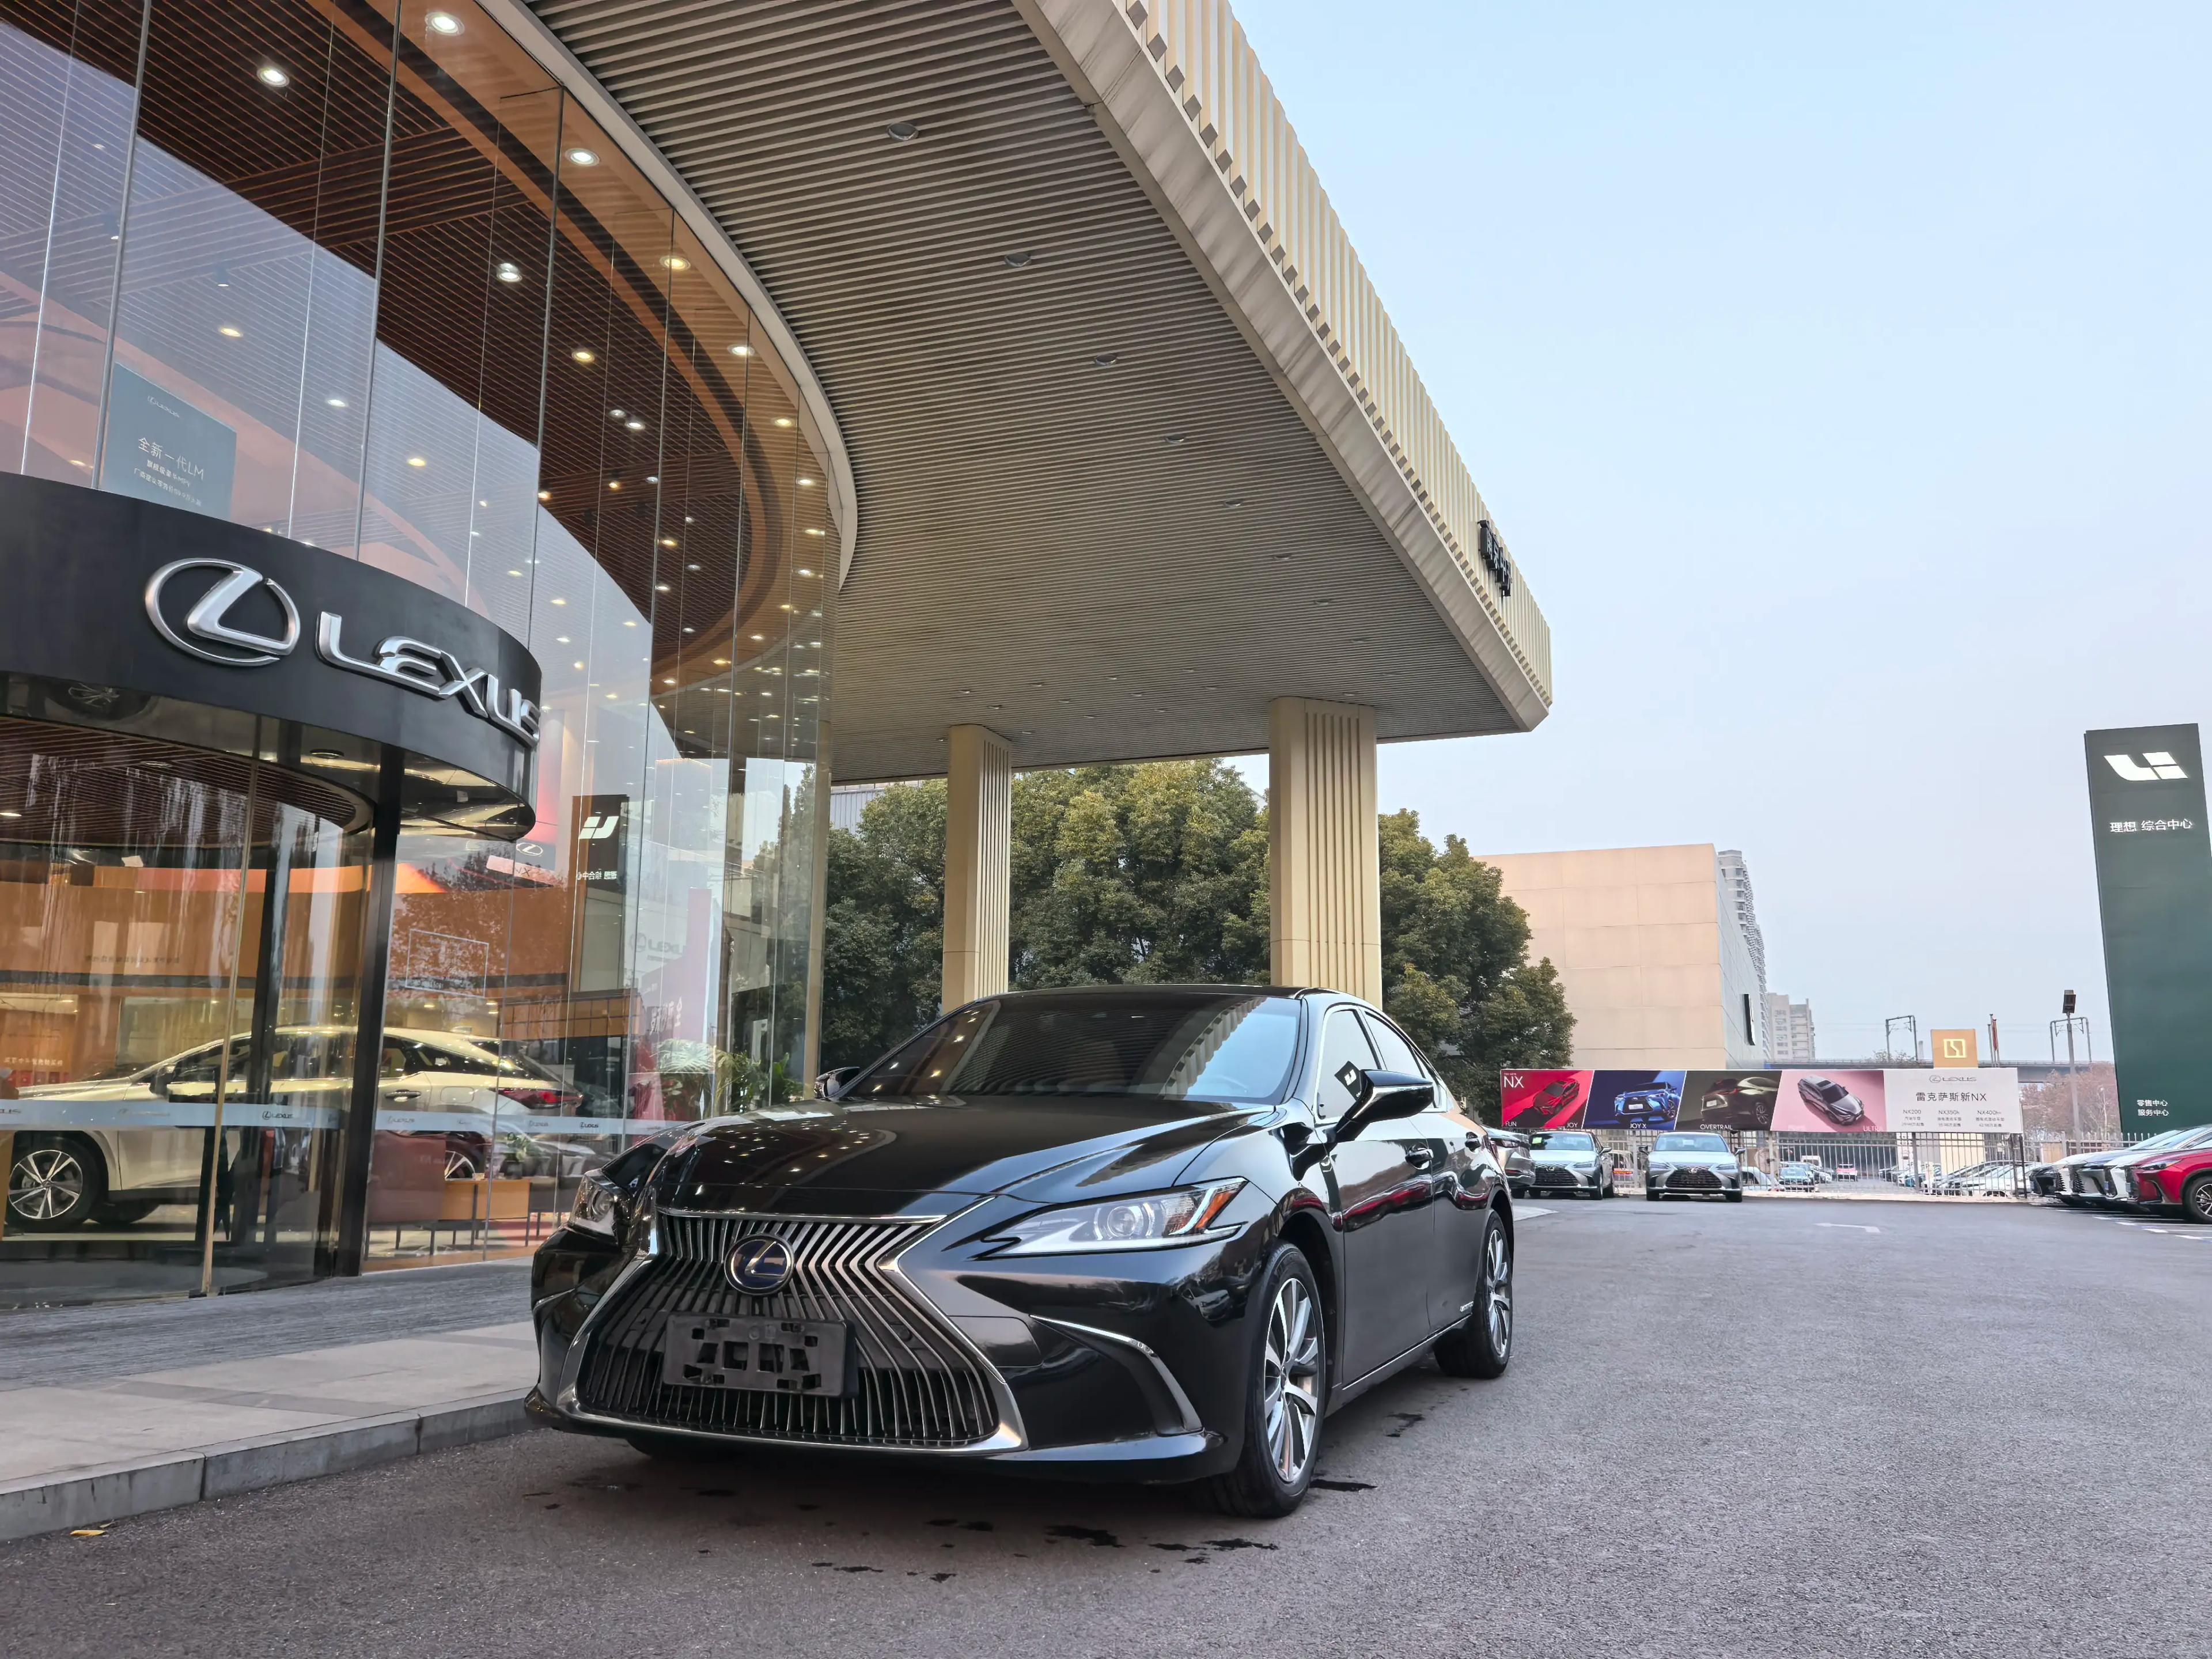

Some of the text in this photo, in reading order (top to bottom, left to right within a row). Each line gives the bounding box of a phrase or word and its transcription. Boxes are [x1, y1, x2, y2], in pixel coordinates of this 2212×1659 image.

[138, 437, 204, 480] 全新一代LM
[315, 611, 541, 748] LEXUS
[2109, 819, 2192, 832] 理想 综合中心
[1503, 1075, 1524, 1088] NX
[1916, 1092, 1987, 1101] 雷克萨斯新NX
